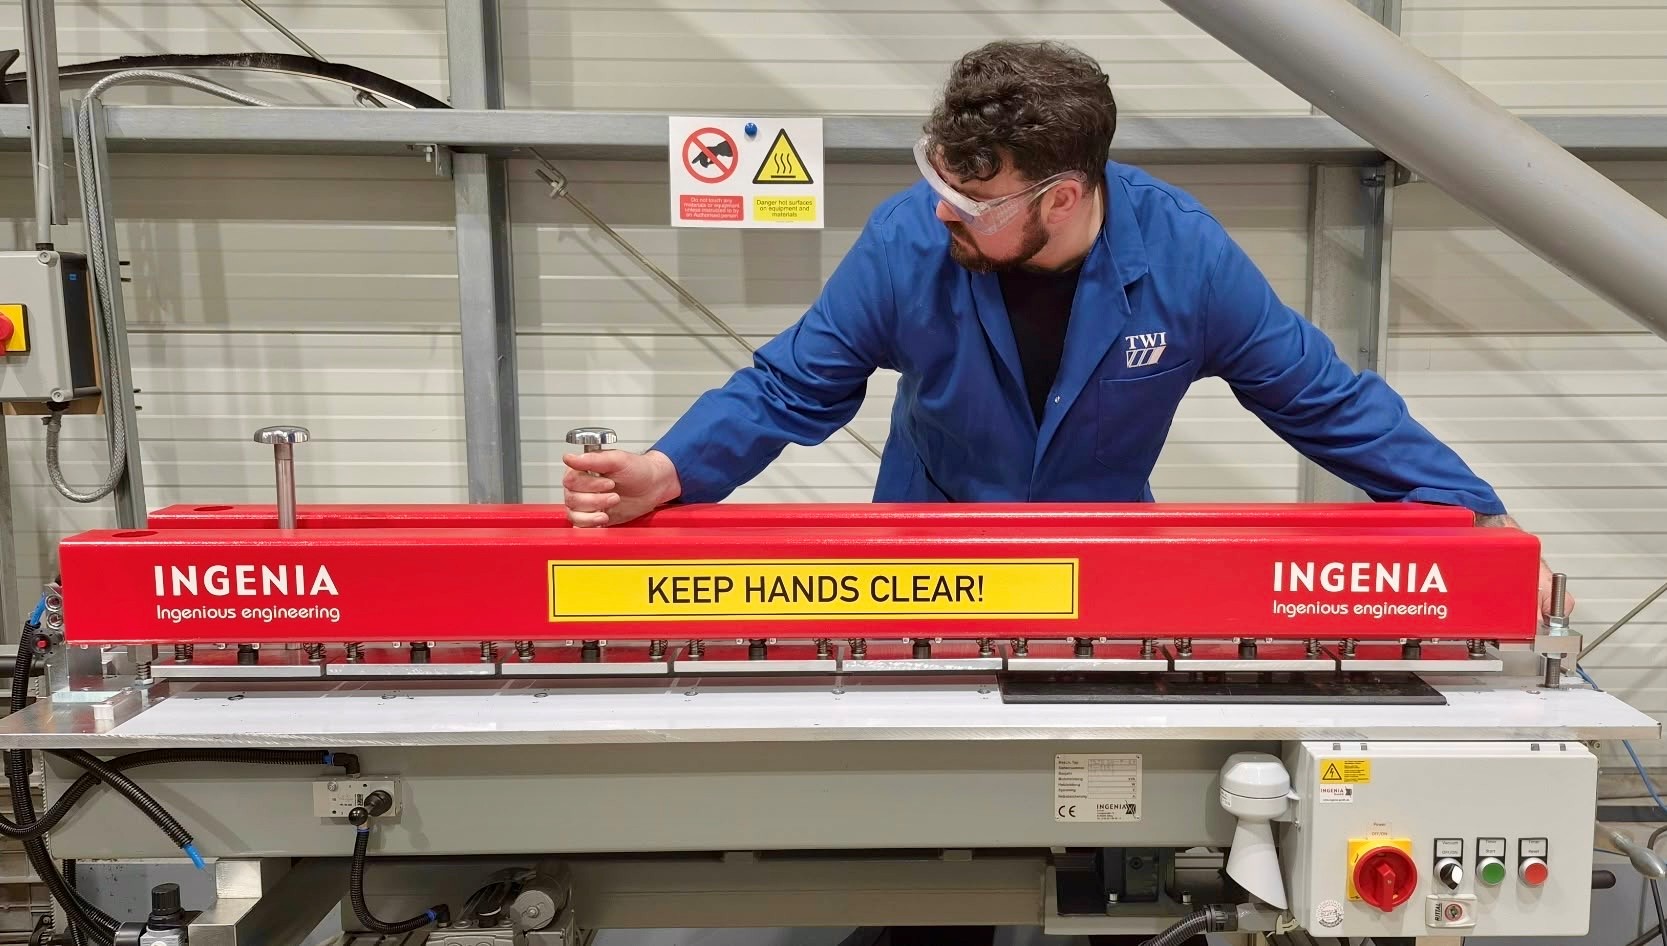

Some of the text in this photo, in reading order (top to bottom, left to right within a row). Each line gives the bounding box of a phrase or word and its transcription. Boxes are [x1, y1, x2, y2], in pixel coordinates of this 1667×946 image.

[1125, 331, 1167, 350] TWI
[154, 564, 339, 597] INGENIA
[1273, 561, 1448, 593] INGENIA
[648, 574, 984, 604] KEEP HANDS CLEAR!
[156, 605, 341, 624] Ingenious engineering
[1273, 600, 1448, 619] Ingenious engineering
[1058, 805, 1076, 818] CE
